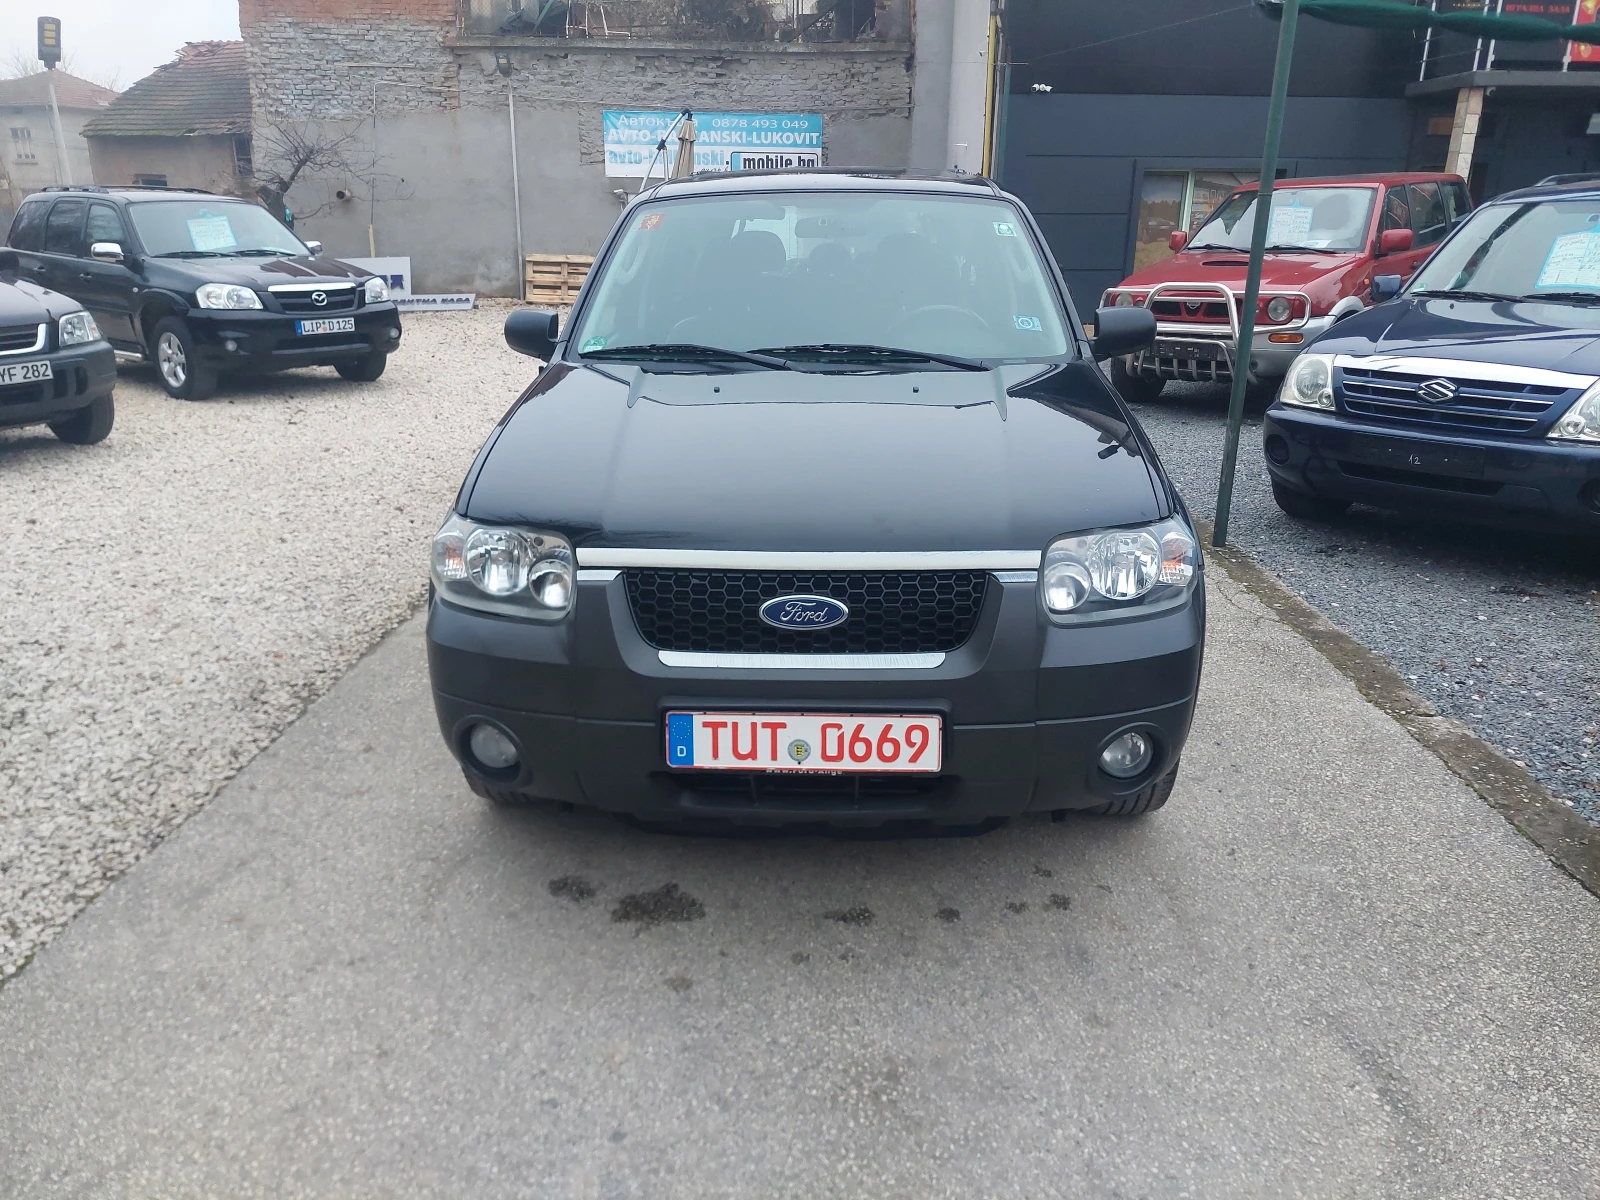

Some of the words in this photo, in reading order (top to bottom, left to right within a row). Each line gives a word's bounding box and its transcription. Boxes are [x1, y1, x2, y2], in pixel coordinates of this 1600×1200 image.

[712, 118, 748, 128] 0878
[751, 119, 778, 129] 493
[781, 120, 809, 129] 049
[303, 322, 321, 333] LIP
[21, 363, 51, 380] 282
[1408, 453, 1421, 465] 12
[779, 600, 828, 622] Ford
[677, 745, 687, 757] D
[702, 721, 787, 761] TUT
[820, 722, 930, 764] 0669
